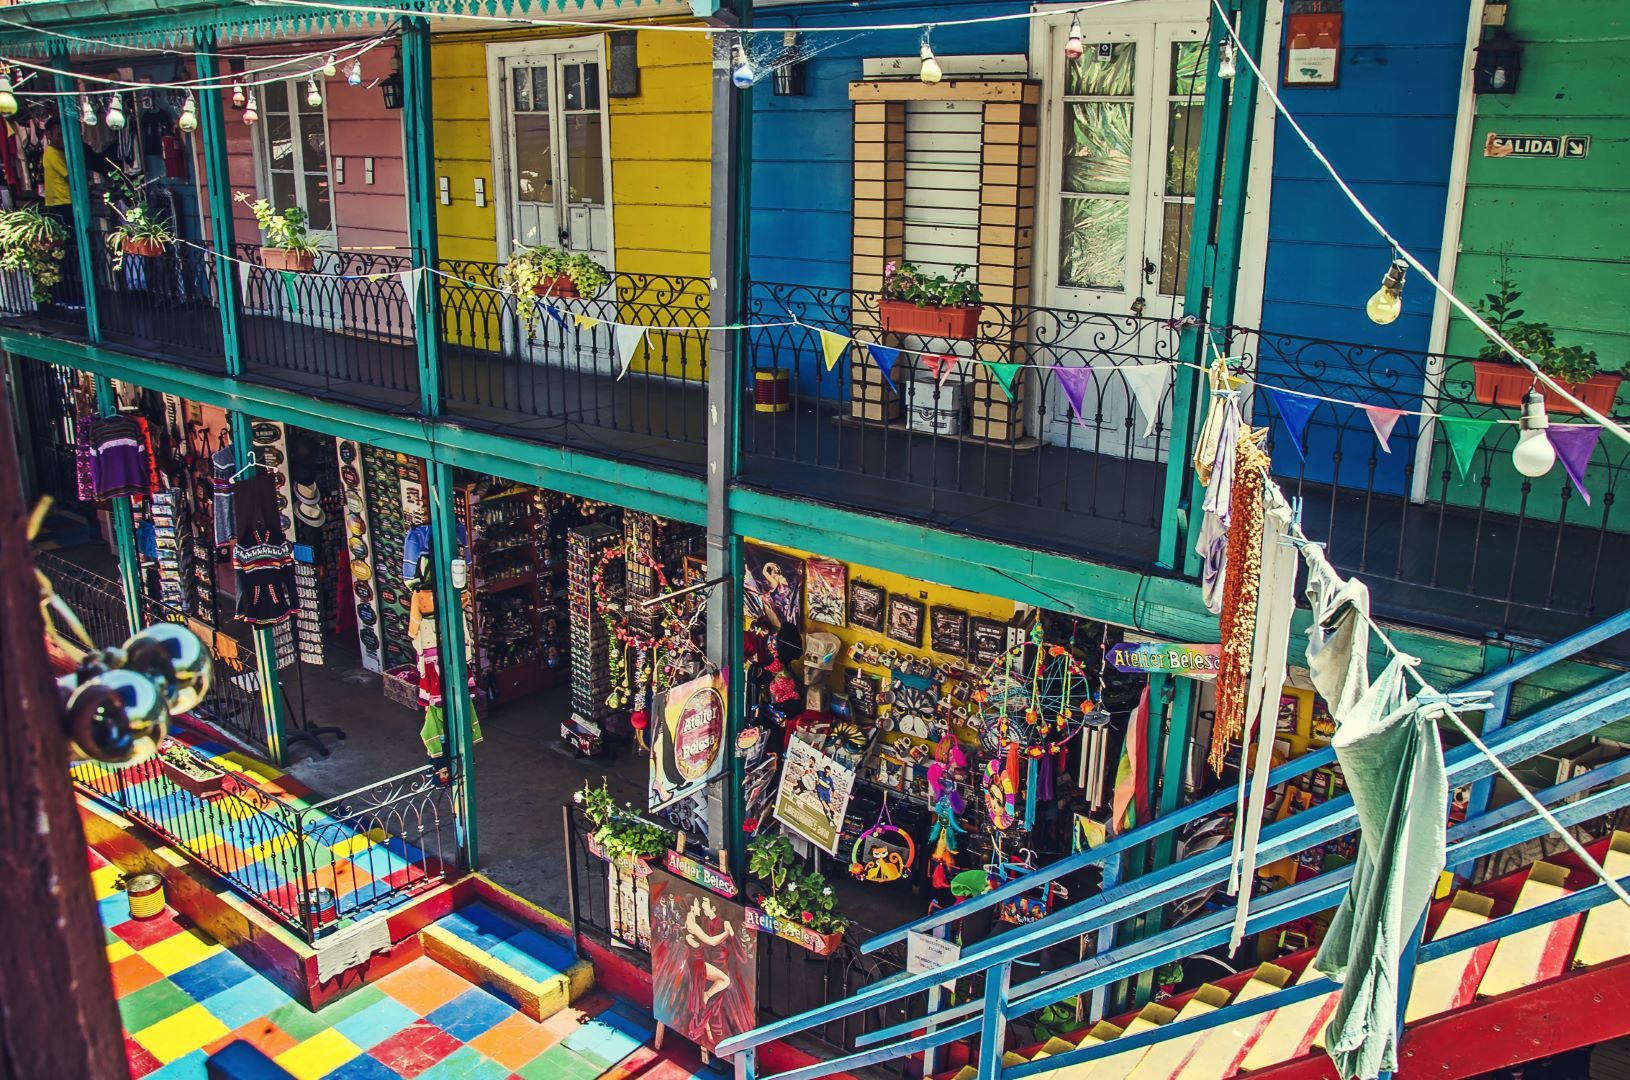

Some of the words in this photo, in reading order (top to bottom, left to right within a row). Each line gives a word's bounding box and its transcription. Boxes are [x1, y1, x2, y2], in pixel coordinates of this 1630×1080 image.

[1114, 649, 1166, 669] Atelier
[682, 707, 718, 734] Atelier
[681, 734, 716, 759] Belesa
[669, 854, 702, 879] Atelier
[746, 911, 784, 931] Atelier
